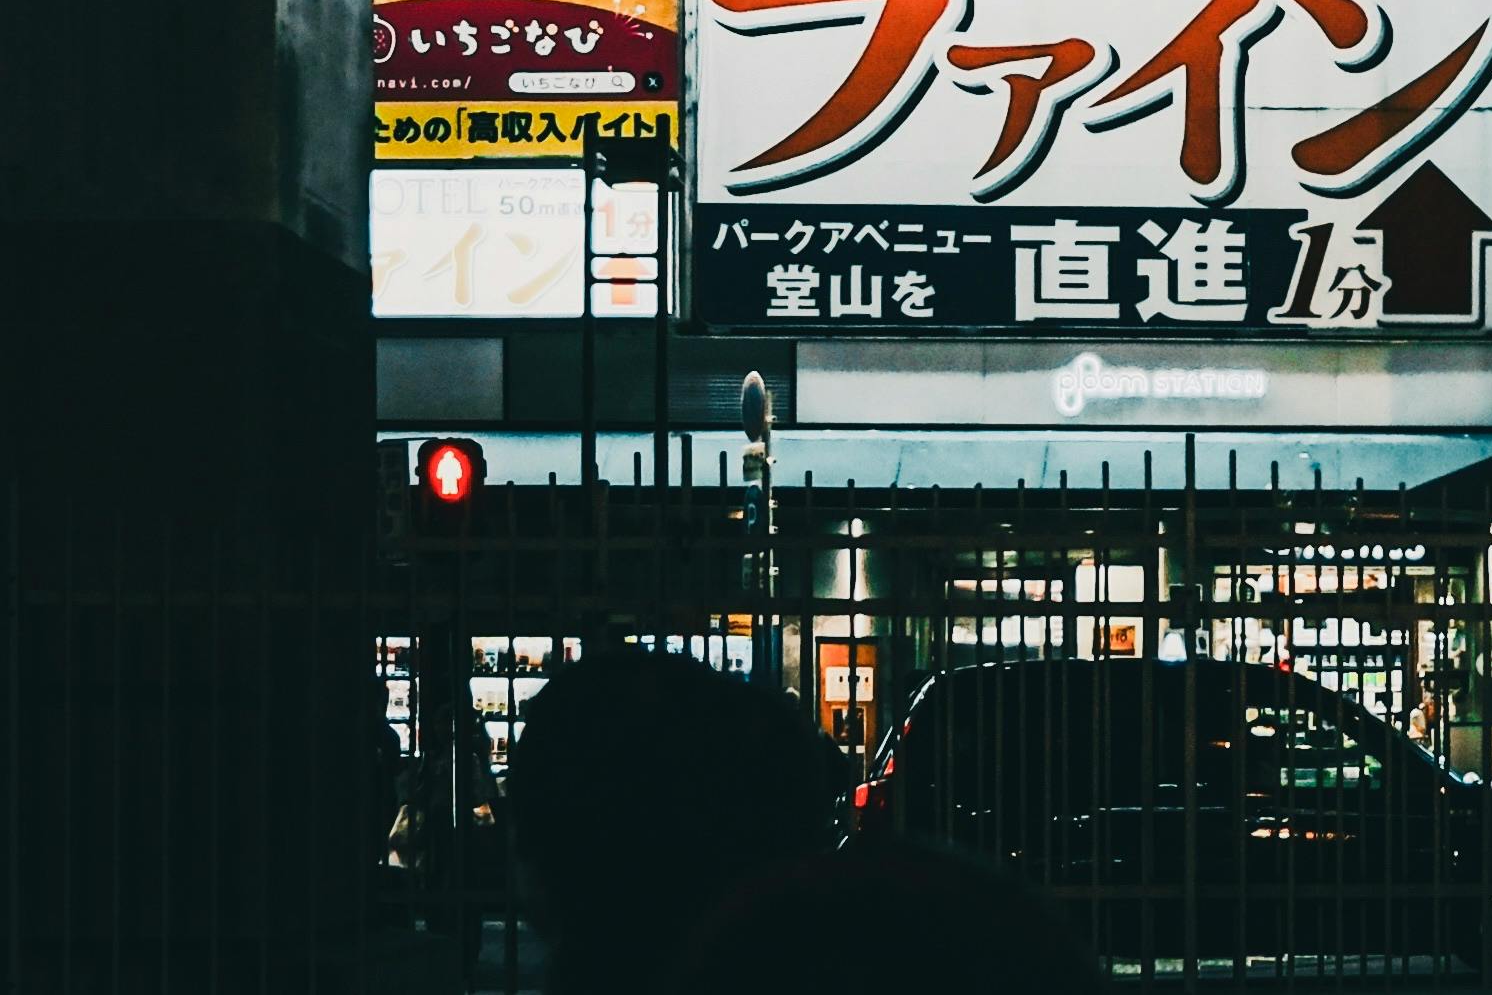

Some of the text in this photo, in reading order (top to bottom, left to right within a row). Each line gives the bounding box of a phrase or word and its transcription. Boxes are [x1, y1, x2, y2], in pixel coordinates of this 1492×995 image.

[411, 18, 604, 56] いちごなび
[712, 217, 992, 254] パークアベニュー
[766, 264, 936, 318] 堂山を
[1011, 218, 1248, 323] 直進
[1274, 220, 1382, 322] 1分
[1154, 369, 1266, 397] STATION
